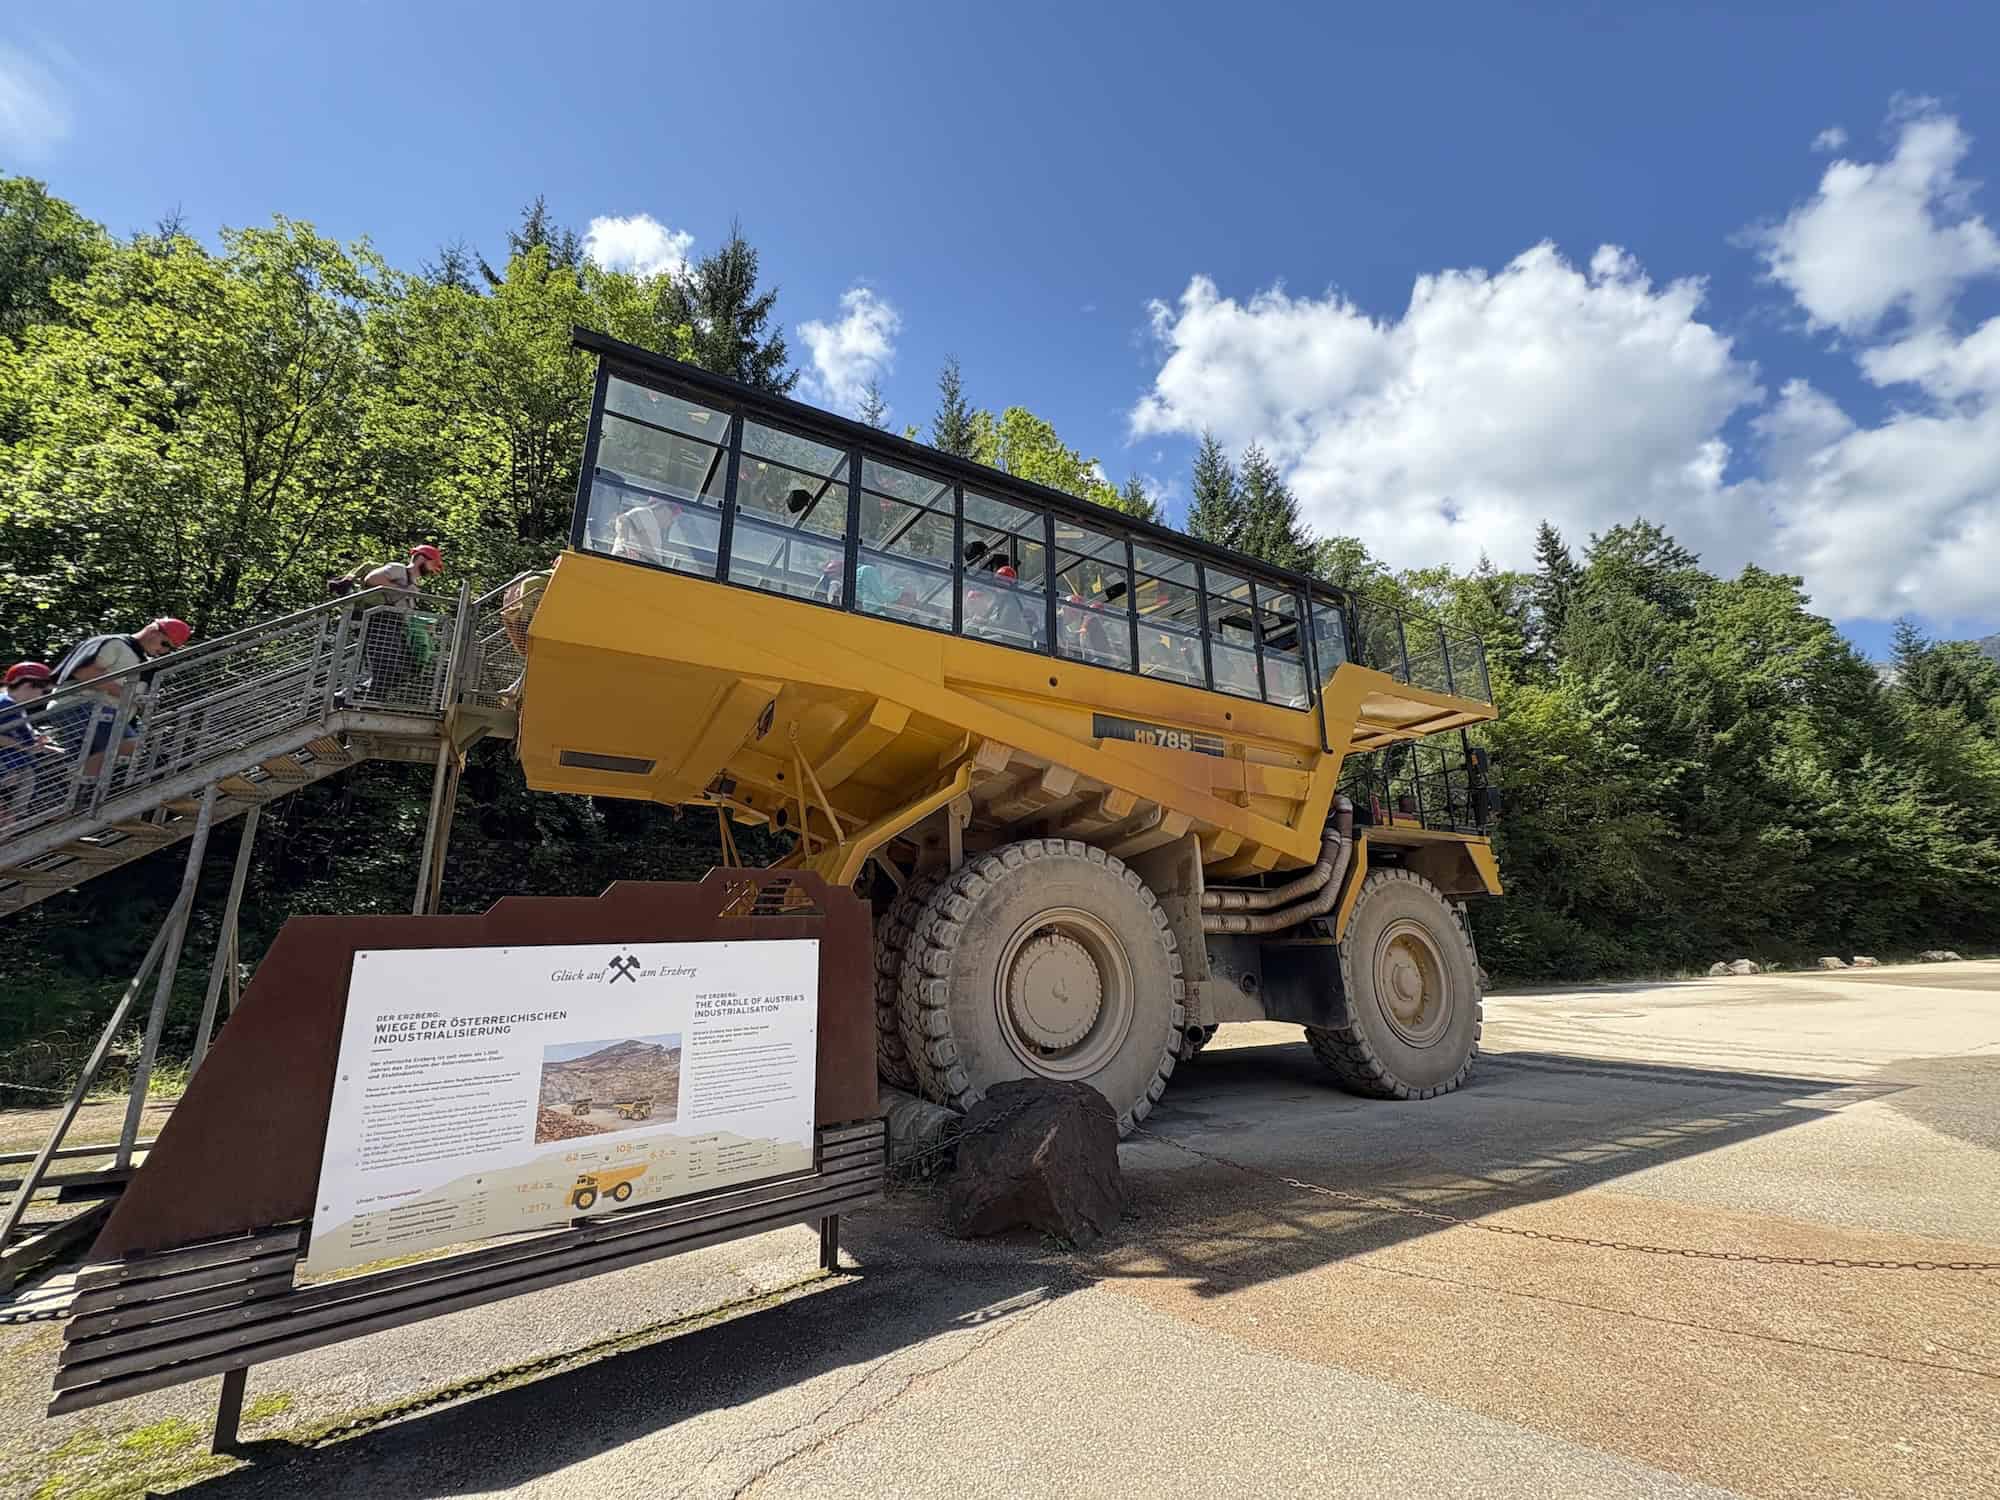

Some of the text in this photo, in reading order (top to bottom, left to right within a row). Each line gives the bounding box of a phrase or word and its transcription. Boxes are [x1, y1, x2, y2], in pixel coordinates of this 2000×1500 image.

[551, 965, 697, 983] Glück auf am Erzberg
[694, 1004, 780, 1018] INDUSTRIALISATION
[695, 1000, 713, 1009] THE
[714, 999, 749, 1008] CRADLE
[751, 997, 761, 1005] OF
[375, 1010, 567, 1033] WIEGE DER ÖSTERREICHISCHEN
[376, 1014, 395, 1023] DER
[373, 1025, 512, 1045] INDUSTRIALISIERUNG
